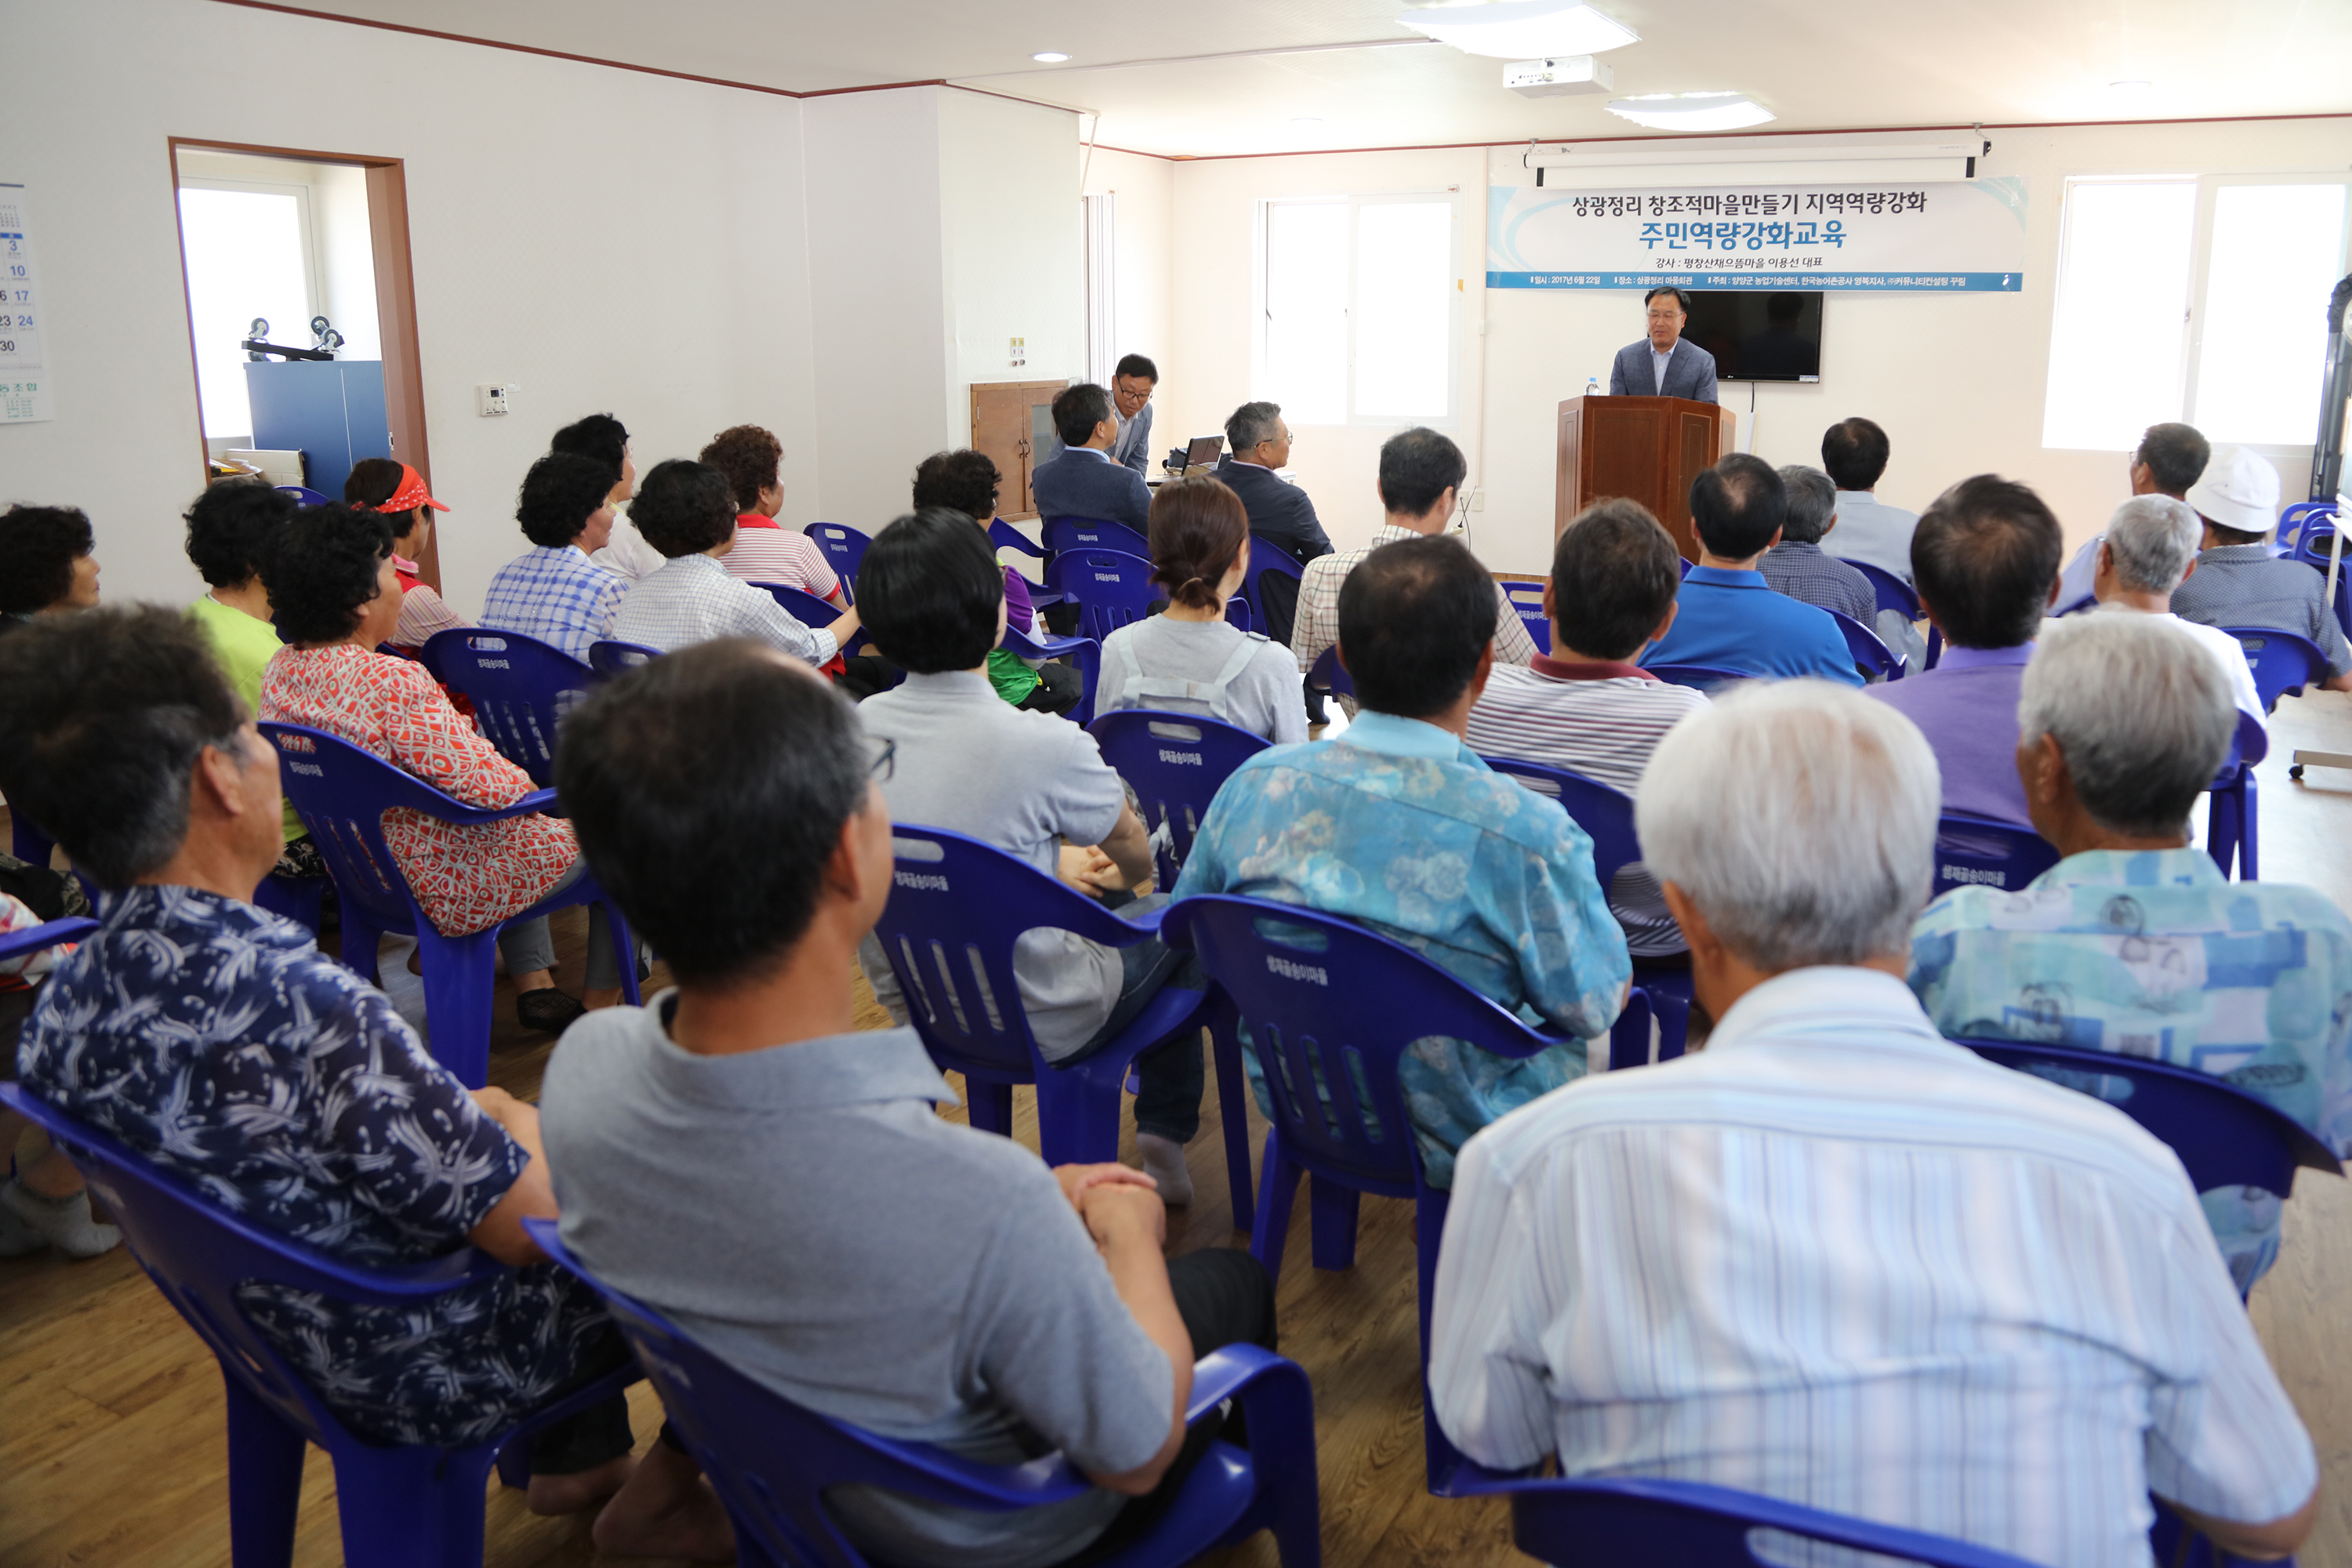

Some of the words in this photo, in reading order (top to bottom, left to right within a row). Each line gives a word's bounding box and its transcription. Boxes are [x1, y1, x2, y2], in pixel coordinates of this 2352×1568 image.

[1572, 195, 1642, 217] 상광정리
[1648, 193, 1798, 217] 창조적마을만들기
[1806, 191, 1928, 215] 지역역량강화
[1639, 220, 1848, 252] 주민역량강화교육
[9, 239, 18, 252] 3
[1656, 257, 1676, 269] 강사
[1683, 257, 1766, 269] 평창산채으뜸마을
[1768, 256, 1800, 269] 이용선
[1802, 256, 1824, 268] 대표
[10, 265, 26, 277] 10
[1534, 275, 1548, 285] 일시
[1551, 275, 1573, 285] 2017년
[1573, 275, 1585, 285] 6월
[1585, 275, 1601, 285] 22일
[1618, 276, 1632, 285] 장소
[1636, 276, 1664, 286] 상광정리
[1665, 276, 1693, 285] 마을회관
[1712, 276, 1727, 286] 주최
[1731, 276, 1755, 286] 양양군
[1755, 276, 1800, 287] 농업기술센터,
[1801, 276, 1853, 286] 한국농어촌공사
[15, 290, 29, 302] 17
[18, 315, 34, 327] 24
[0, 340, 15, 352] 30
